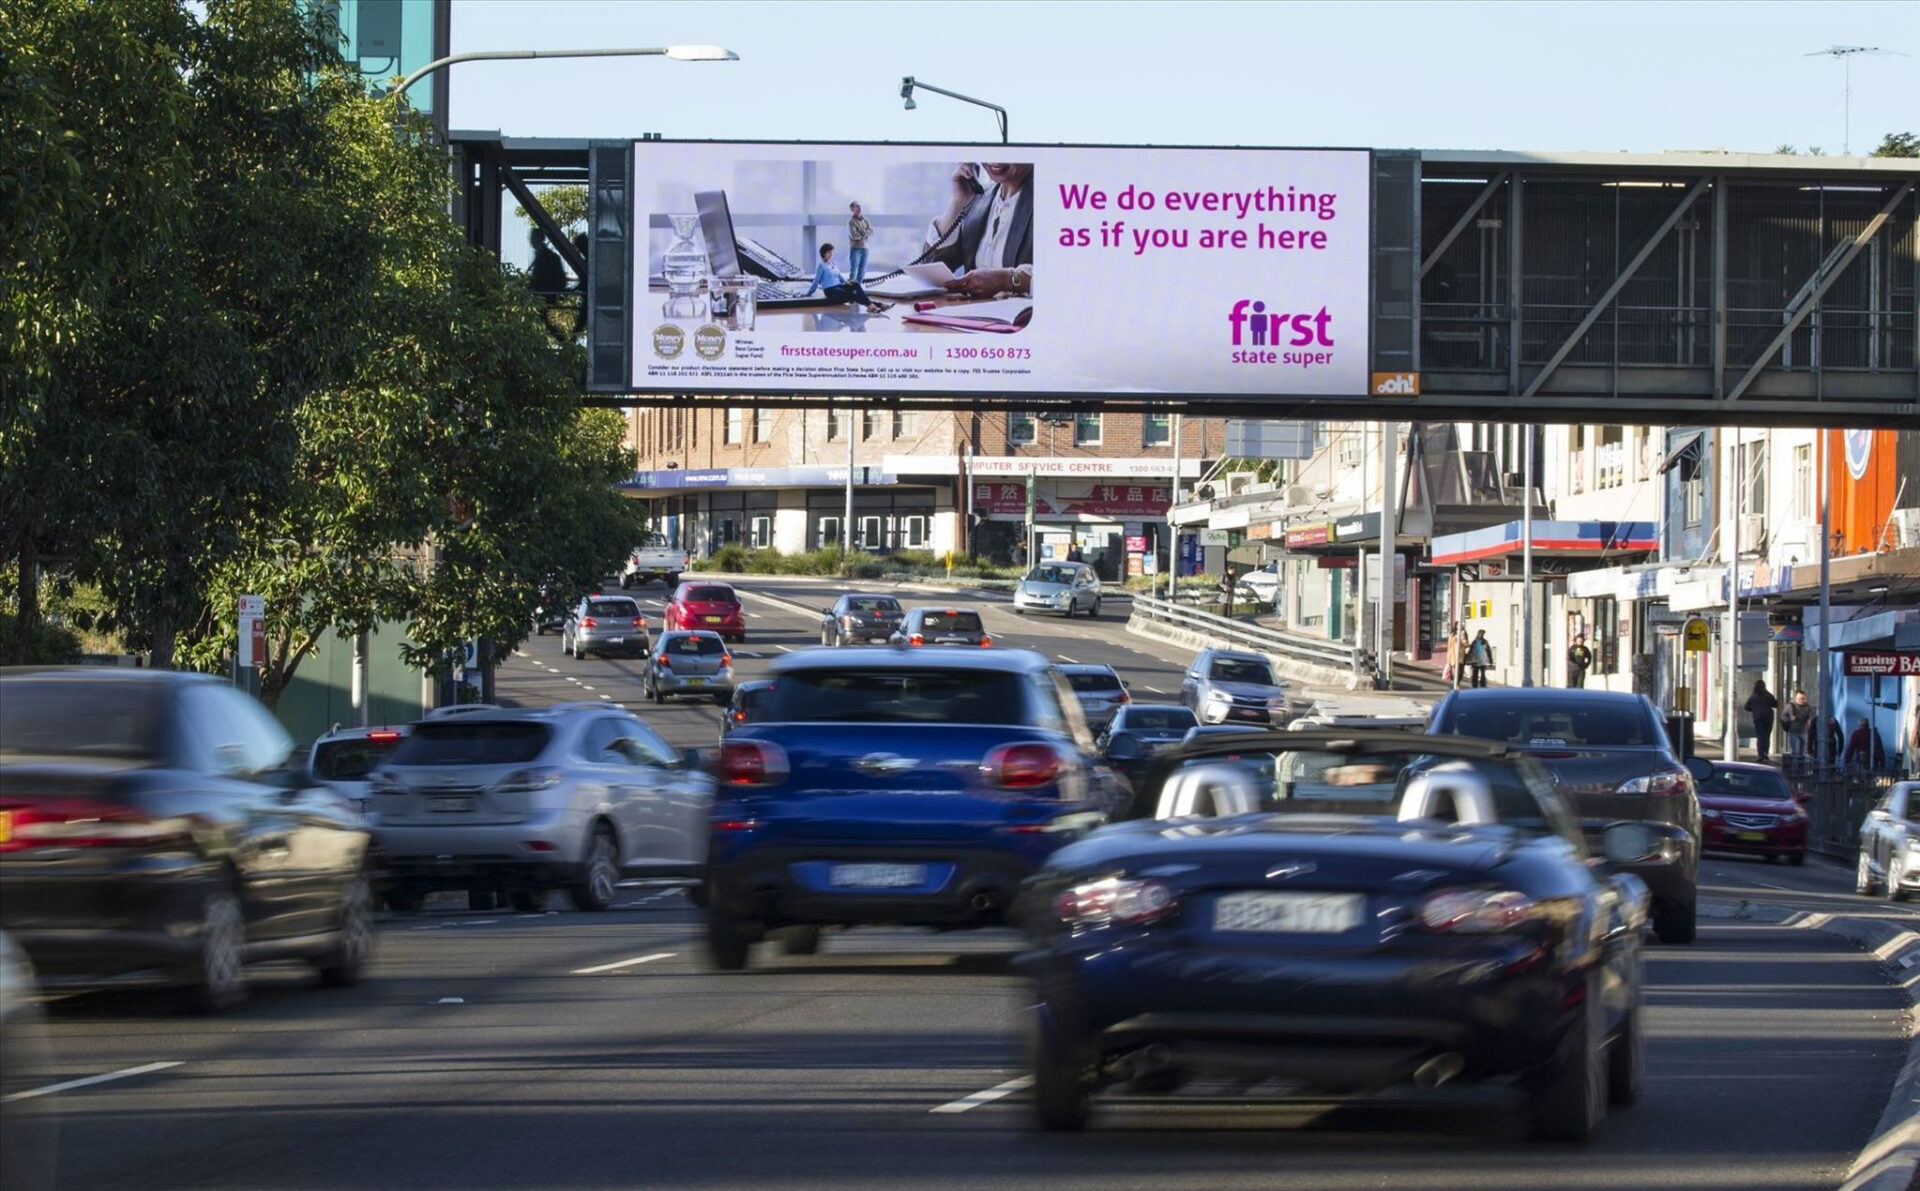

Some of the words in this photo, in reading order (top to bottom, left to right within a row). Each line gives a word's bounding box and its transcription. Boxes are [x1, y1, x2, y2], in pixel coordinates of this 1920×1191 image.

[1059, 184, 1107, 210] We
[1117, 185, 1156, 211] do
[1165, 186, 1336, 220] everything
[1059, 226, 1090, 247] as
[1100, 221, 1125, 248] if
[1133, 228, 1189, 255] you
[1200, 228, 1247, 249] are
[1258, 223, 1327, 250] here
[1229, 300, 1334, 347] first
[781, 345, 918, 360] firststatesuper.com.au
[946, 347, 977, 359] 1300
[981, 347, 1005, 360] 650
[1007, 347, 1031, 360] 873
[1232, 349, 1277, 364] state
[1282, 350, 1333, 368] super
[1018, 462, 1064, 473] SERVICE
[1069, 462, 1113, 473] CENTRE
[1851, 655, 1897, 667] Epping
